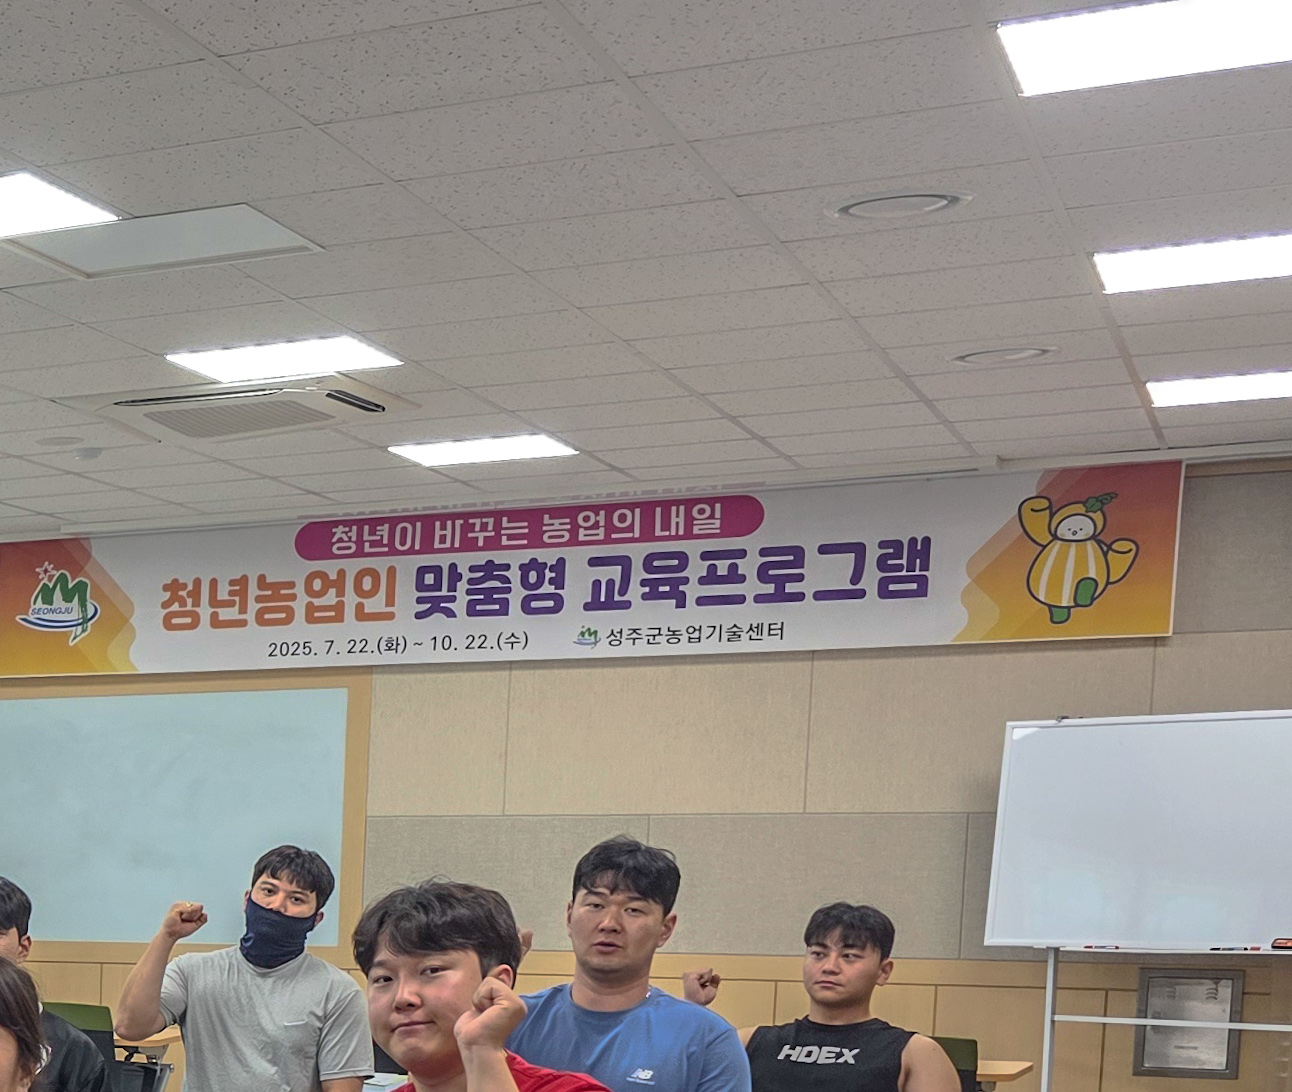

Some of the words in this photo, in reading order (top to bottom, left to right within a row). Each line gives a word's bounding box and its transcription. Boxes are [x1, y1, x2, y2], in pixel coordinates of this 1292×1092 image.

[330, 514, 421, 555] 청년이
[433, 516, 529, 549] 바꾸는
[542, 508, 641, 543] 농업의
[654, 503, 722, 537] 내일
[160, 565, 397, 632] 청년농업인
[414, 556, 566, 620] 맞춤형
[582, 536, 932, 612] 교육프로그램
[30, 606, 74, 616] SEONGJU
[267, 641, 318, 657] 2025.
[324, 640, 341, 655] 7.
[347, 635, 407, 655] 22.(화)
[430, 635, 458, 651] 10.
[464, 630, 529, 651] 22.(수)
[606, 621, 785, 647] 성주군농업기술센터
[777, 1044, 861, 1065] HDEX
